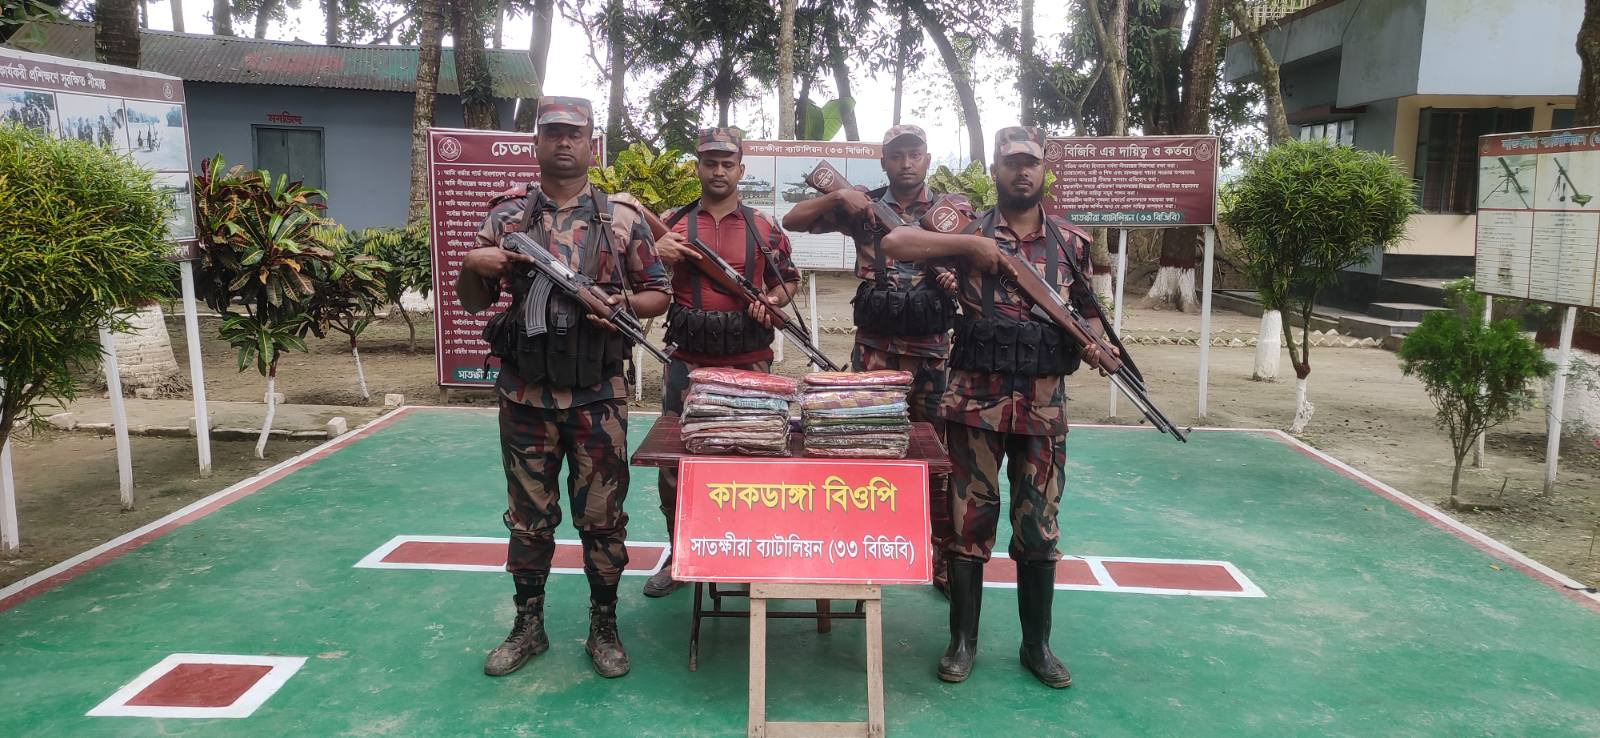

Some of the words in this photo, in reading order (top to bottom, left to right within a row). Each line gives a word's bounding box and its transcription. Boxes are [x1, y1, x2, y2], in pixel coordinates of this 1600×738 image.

[29, 66, 60, 84] প্রশিক্ষণে
[61, 71, 86, 88] সুরক্ষিত
[492, 141, 538, 158] চেতনা
[750, 144, 783, 153] সাতক্ষীরা
[785, 145, 823, 154] ব্যাটালিয়ন
[845, 146, 875, 156] বিজিবি)
[1064, 143, 1097, 157] বিজিবি
[1099, 147, 1116, 157] এর
[1118, 143, 1149, 159] দায়িত্ব
[1152, 146, 1161, 156] ও
[1163, 142, 1194, 157] কর্তব্য
[1071, 211, 1100, 222] সাতক্ষীরা
[1101, 211, 1134, 222] ব্যাটালিয়ন
[1136, 212, 1152, 222] (৩৩
[1153, 212, 1181, 222] বিজিবি)
[706, 480, 816, 512] কাকডাঙ্গা
[822, 475, 898, 512] বিওপি
[689, 531, 752, 558] সাতক্ষীরা
[756, 533, 824, 559] ব্যাটালিয়ন
[828, 539, 859, 564] (৩৩
[863, 535, 915, 565] বিজিবি)
